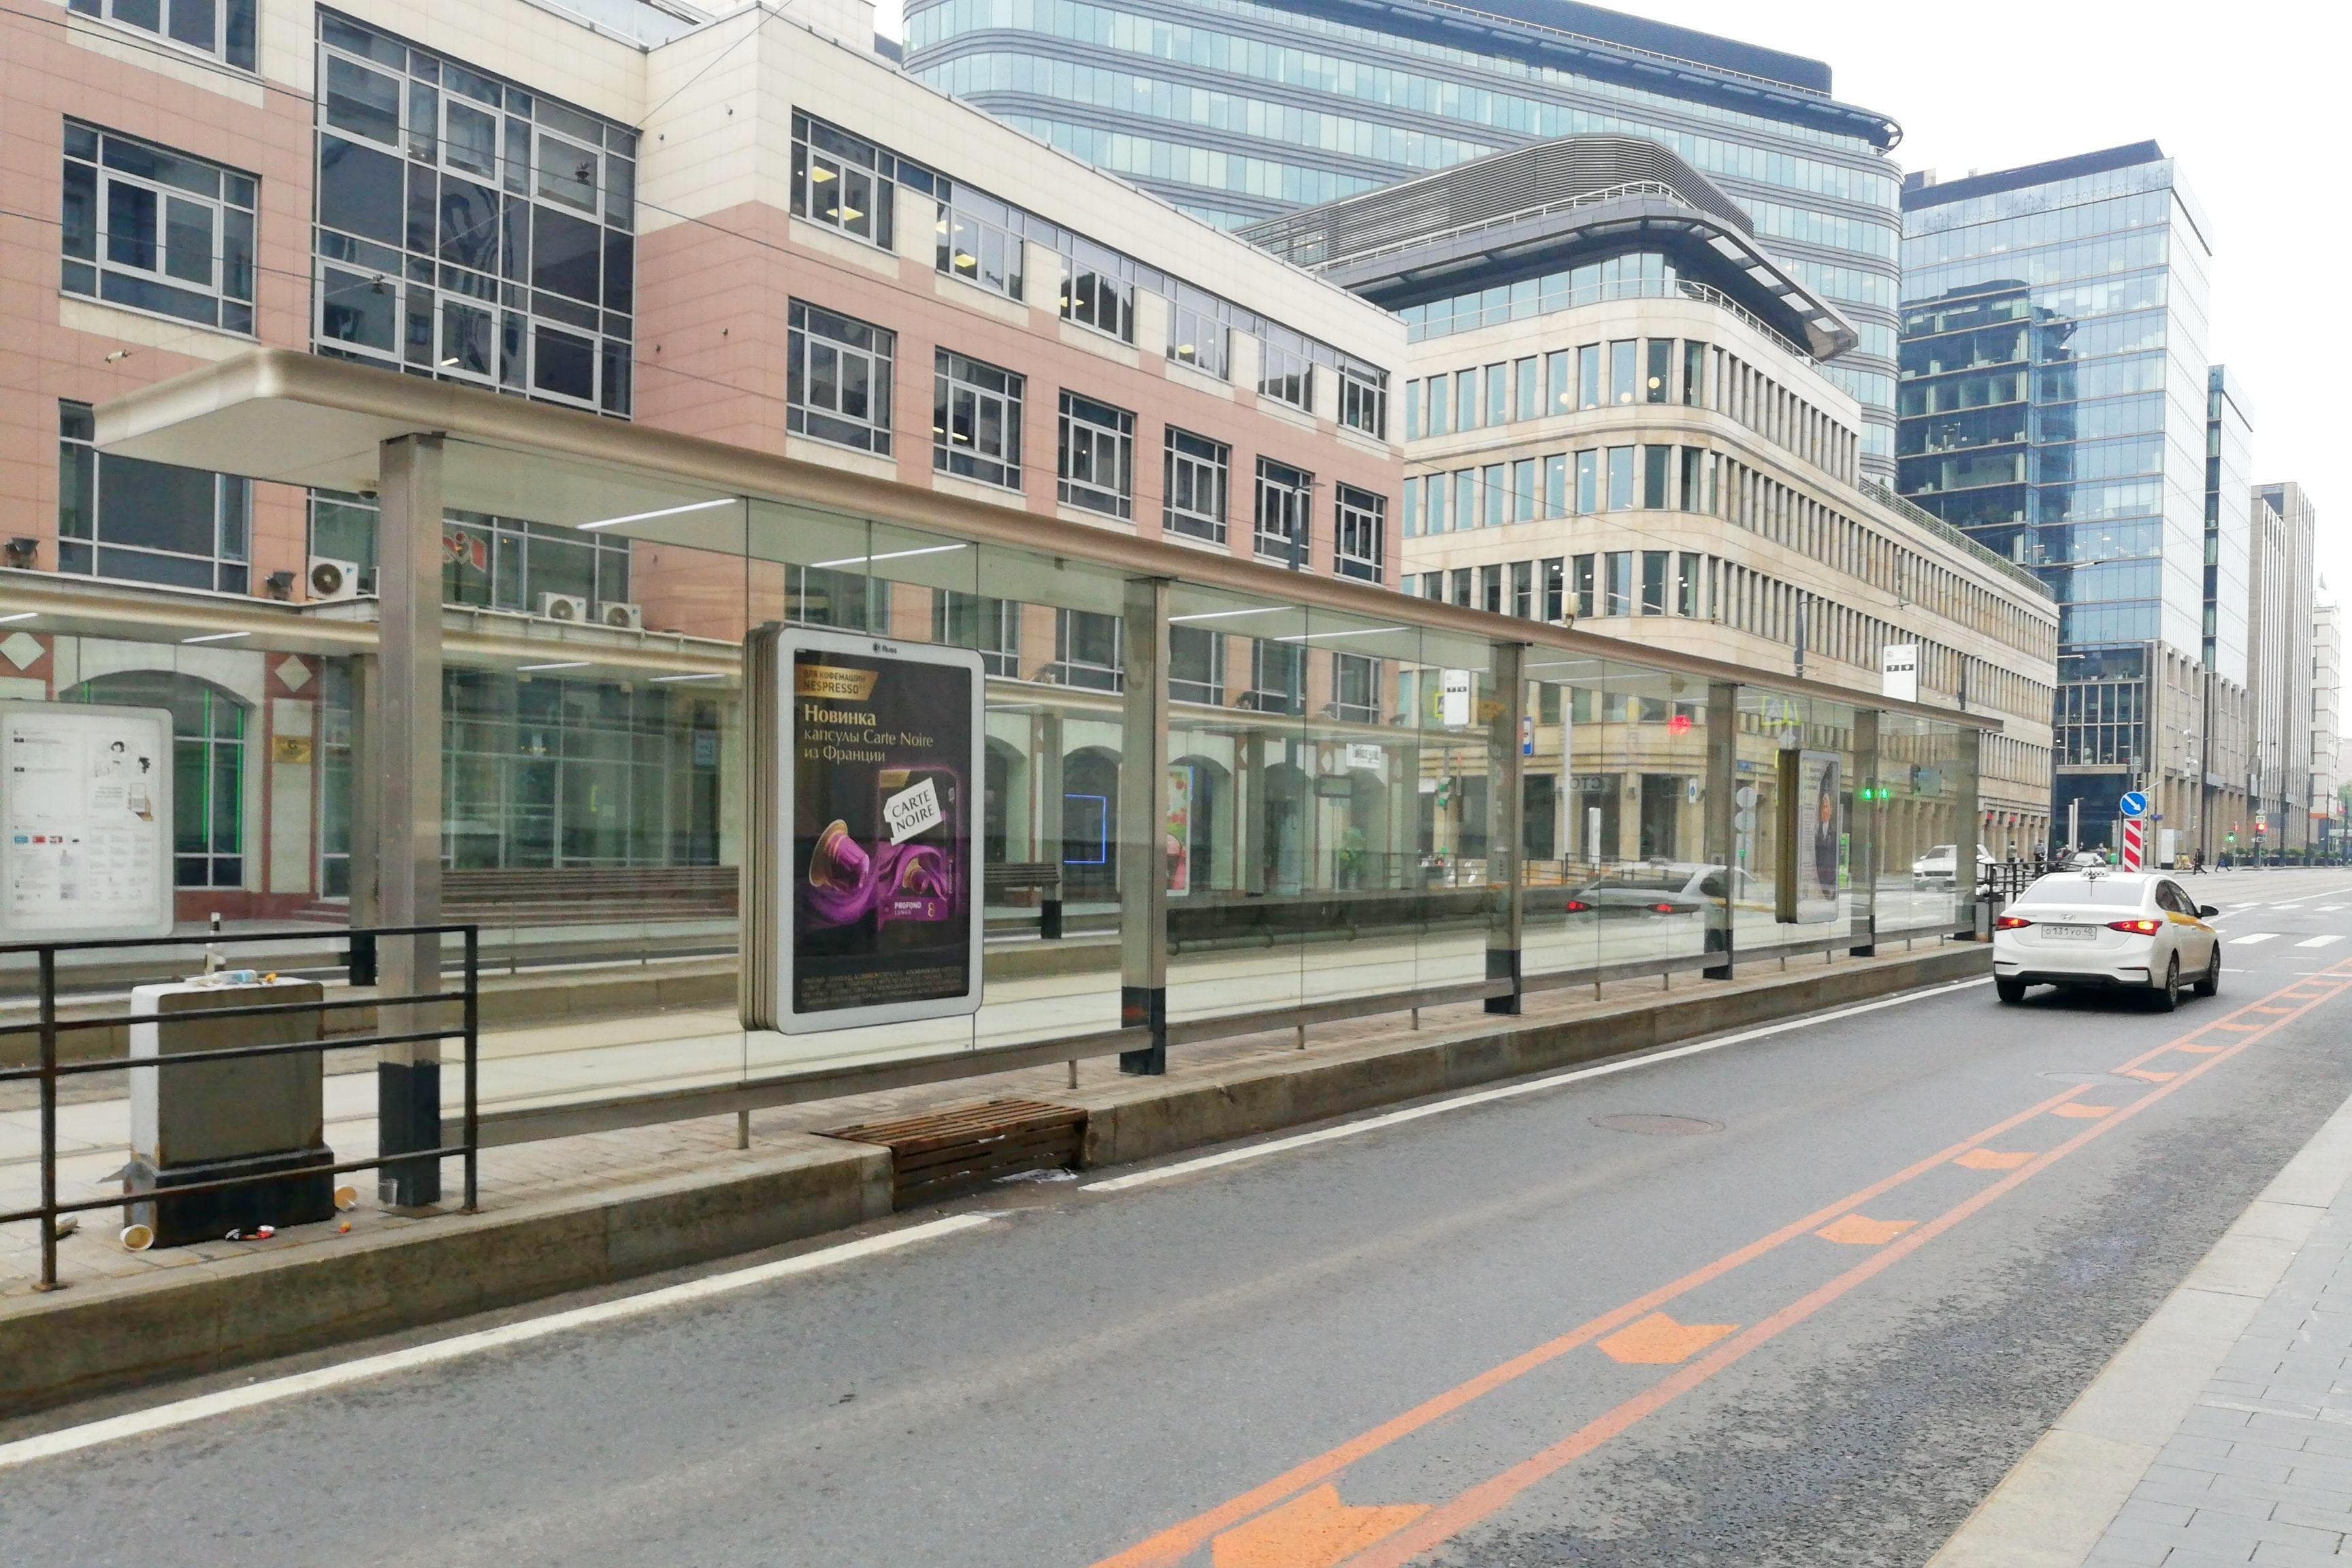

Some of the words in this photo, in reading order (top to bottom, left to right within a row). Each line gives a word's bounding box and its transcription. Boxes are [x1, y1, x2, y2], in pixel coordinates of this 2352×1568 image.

[819, 670, 866, 682] КОФЕМАШИН
[803, 681, 859, 694] NESPRESSO
[804, 704, 877, 726] Новинка
[804, 729, 860, 746] капсулы
[864, 729, 896, 745] Carte
[900, 732, 934, 747] Noire
[804, 749, 819, 759] из
[823, 745, 885, 764] Франции
[892, 789, 931, 818] CARTE
[896, 804, 934, 832] NOIRE
